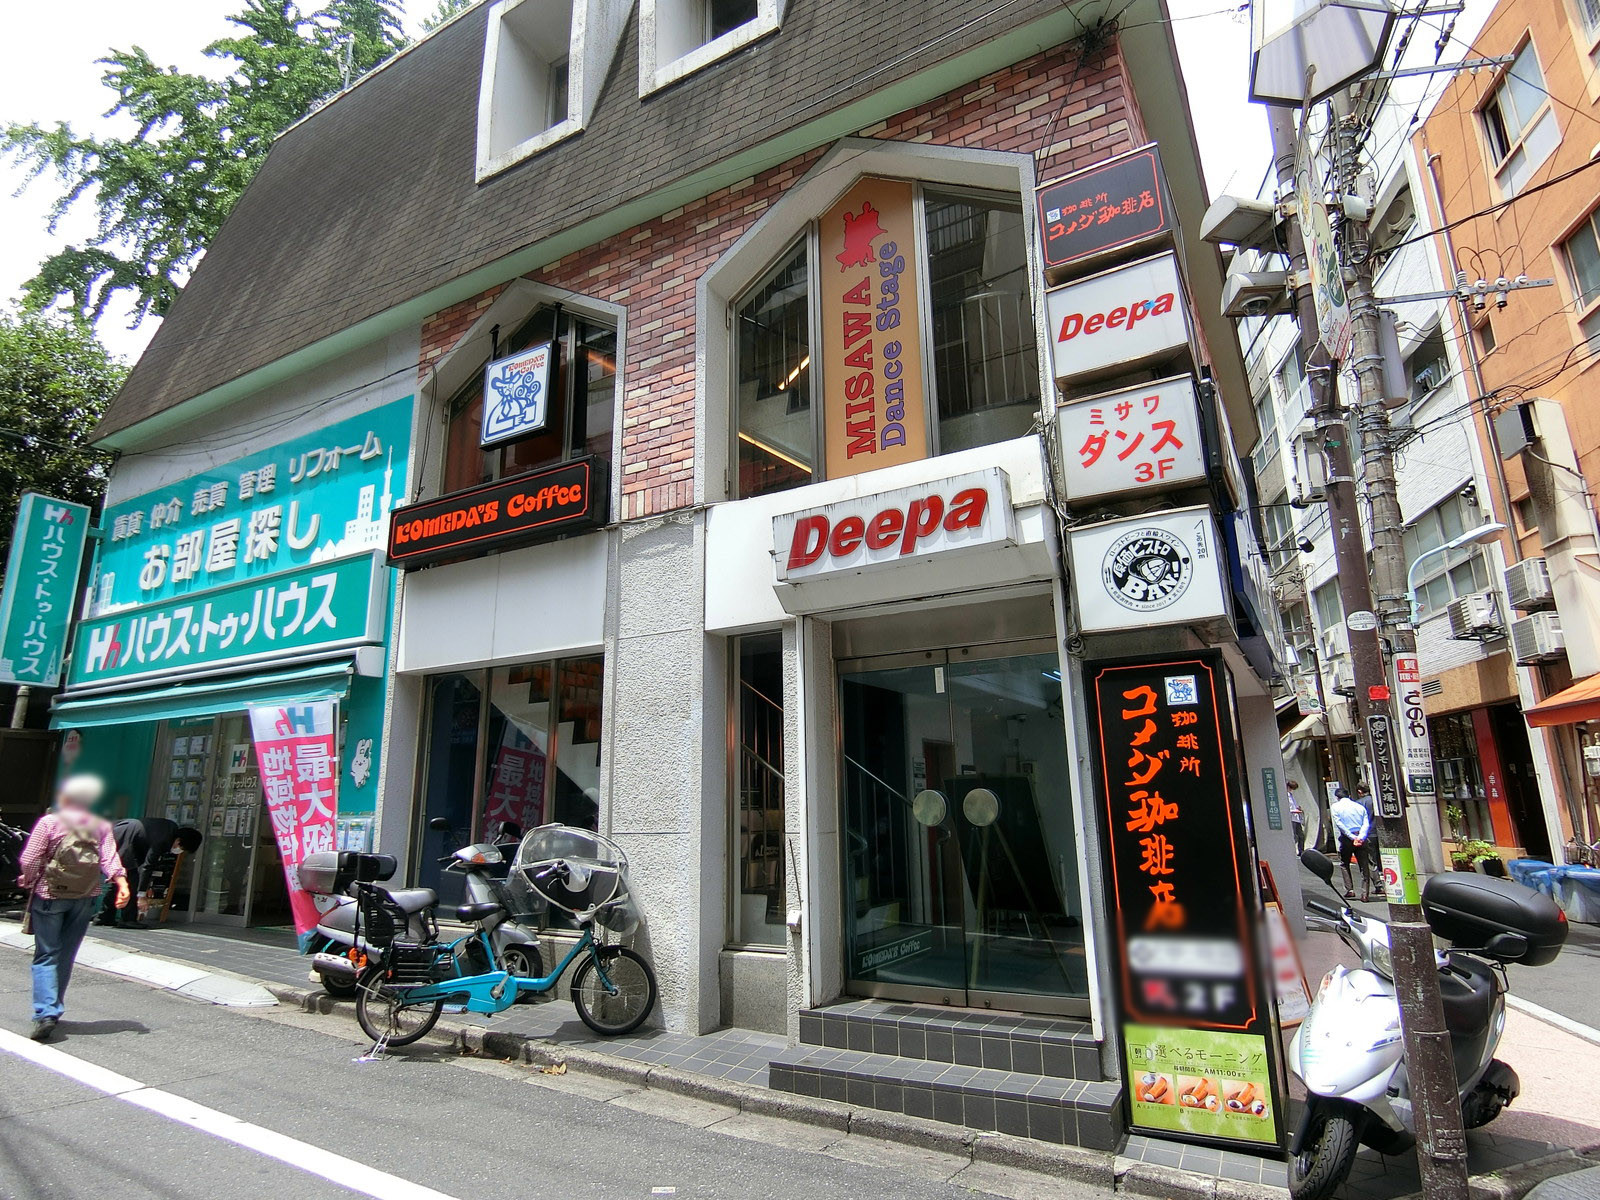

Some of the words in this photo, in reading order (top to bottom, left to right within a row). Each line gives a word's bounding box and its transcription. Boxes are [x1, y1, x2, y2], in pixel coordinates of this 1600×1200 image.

[1049, 190, 1154, 241] コメダ珈琲店
[876, 241, 907, 333] Stage
[1058, 292, 1175, 343] Deepa
[842, 276, 878, 460] MISAWA
[881, 339, 907, 452] Dance
[1078, 419, 1184, 469] ダンス
[1090, 395, 1160, 425] ミサワ
[112, 509, 143, 542] 賃貸
[150, 496, 183, 530] 仲介
[191, 481, 229, 516] 売買
[238, 463, 277, 501] 管理
[289, 431, 383, 484] リフォーム
[1134, 457, 1175, 483] 3F
[139, 500, 321, 591] お部屋探し
[396, 501, 499, 545] KOMEDA'S
[507, 484, 582, 518] Coffee
[787, 486, 989, 571] Deepa
[17, 524, 66, 677] ハウス・トゥ・ハウス
[121, 572, 338, 668] ハウス・トゥ・ハウス
[1404, 689, 1426, 738] さのや
[1155, 1044, 1263, 1064] 選べるモーニング
